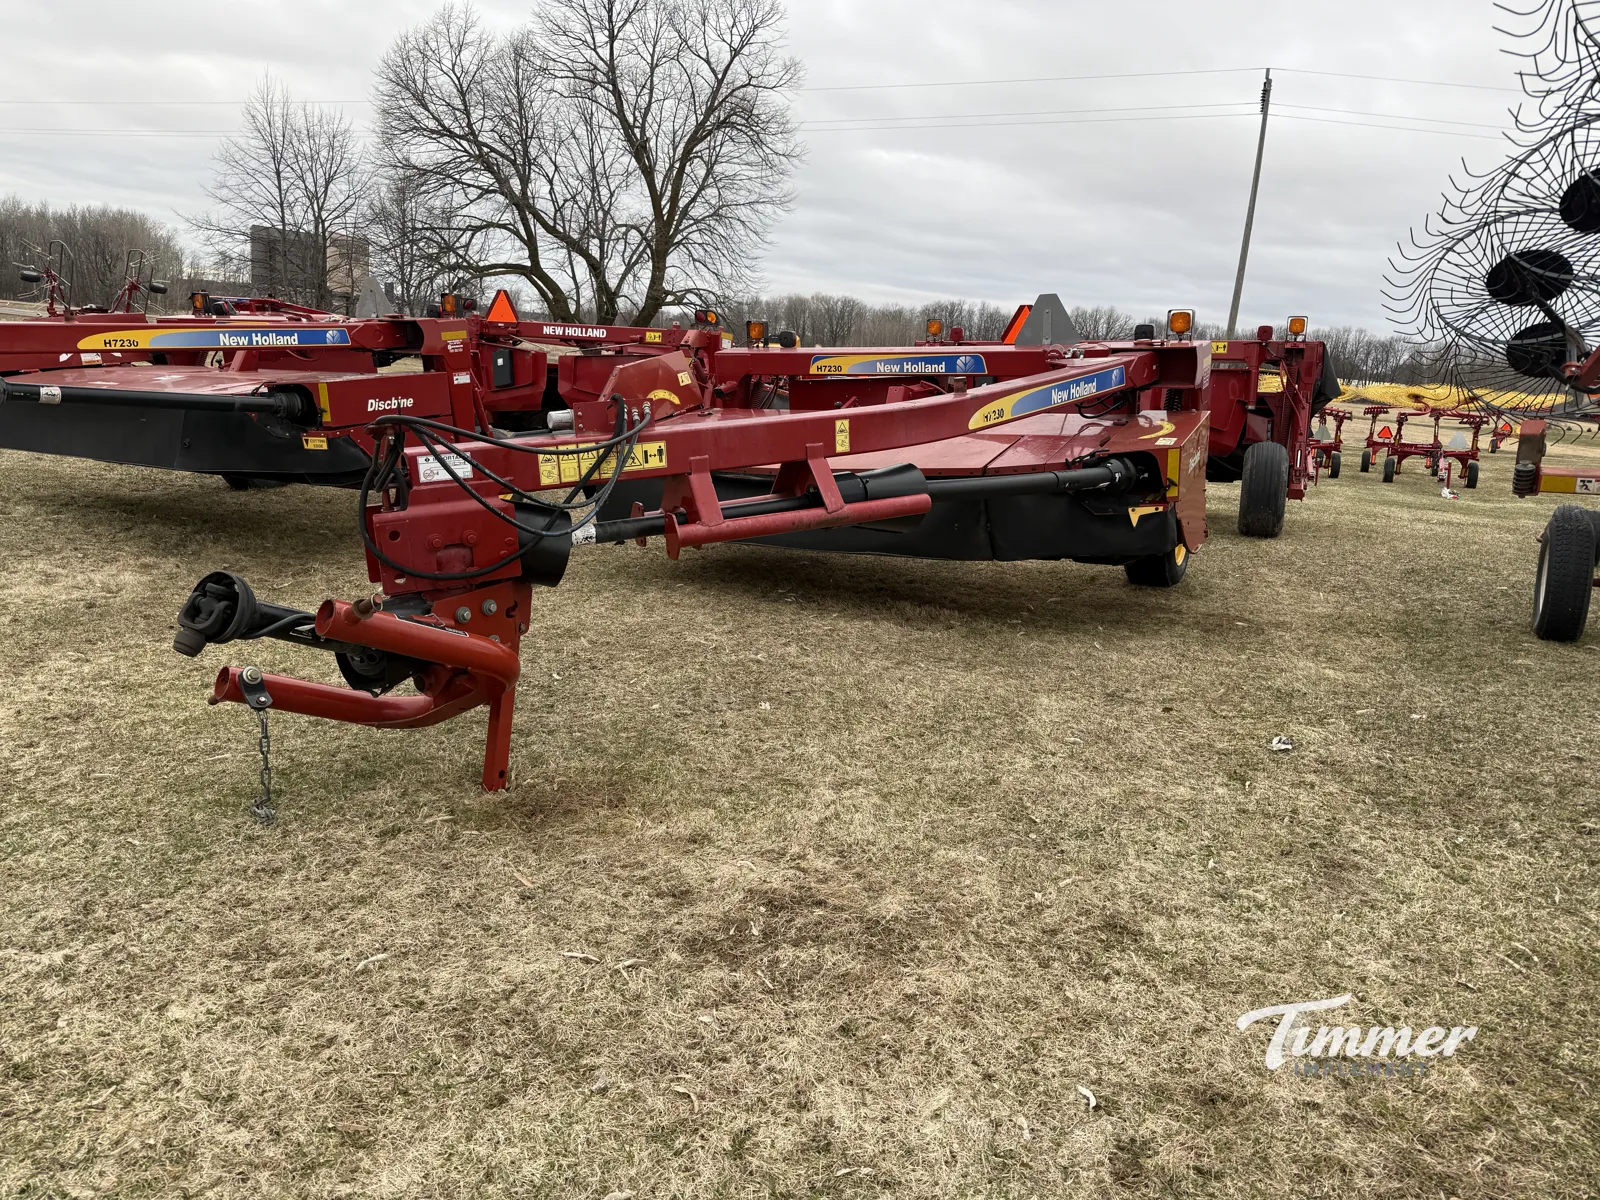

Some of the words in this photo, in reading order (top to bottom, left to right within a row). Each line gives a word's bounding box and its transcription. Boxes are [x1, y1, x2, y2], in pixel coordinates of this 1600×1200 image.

[543, 325, 563, 336] NEW
[565, 326, 607, 338] HOLLAND
[103, 339, 139, 348] H7230
[219, 333, 248, 346] New
[252, 333, 299, 345] Holland
[816, 365, 843, 373] H7230
[876, 362, 900, 373] New
[904, 362, 946, 373] Holland
[1051, 388, 1068, 405] New
[1070, 378, 1097, 399] Holland
